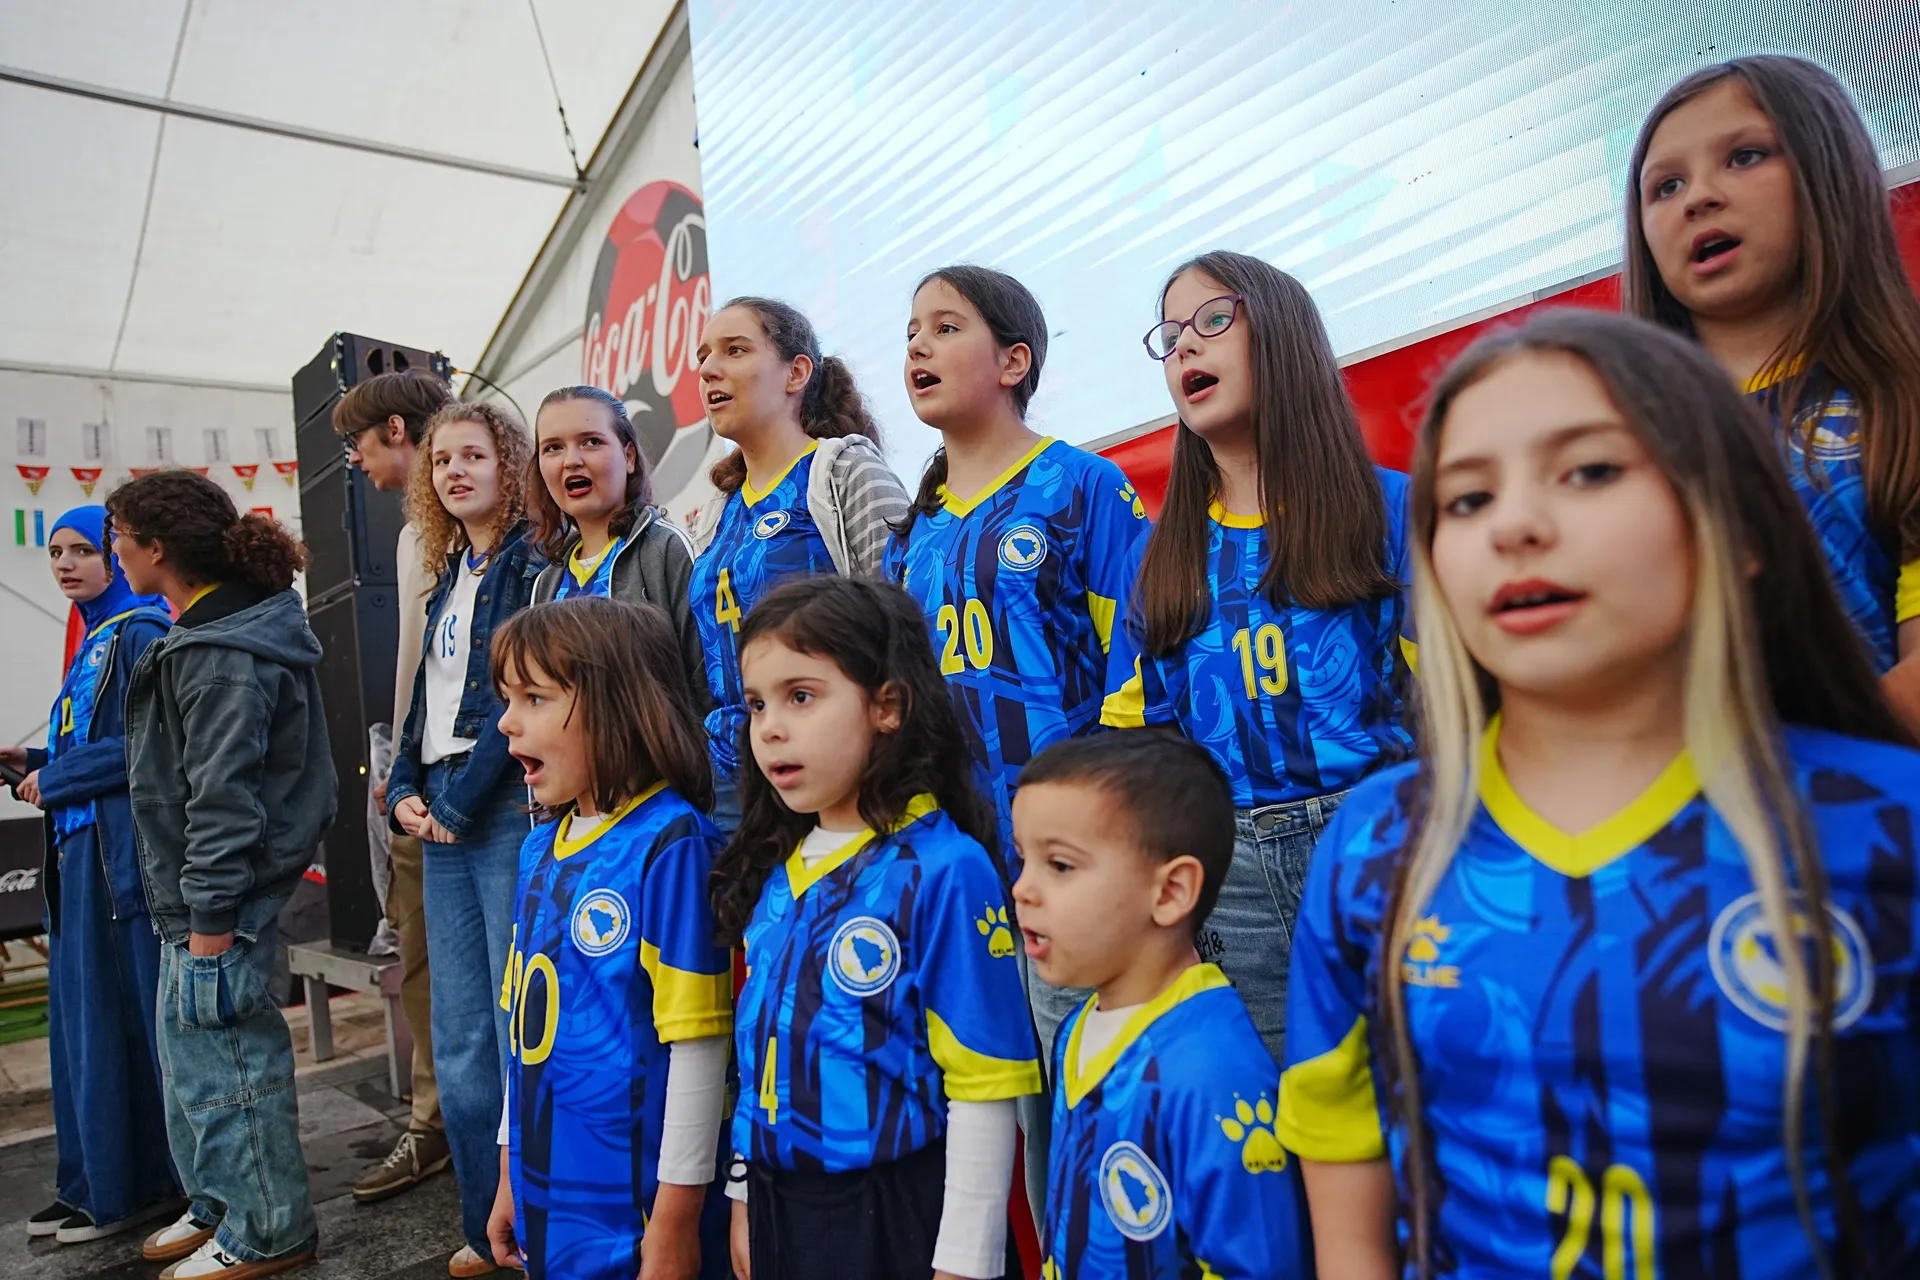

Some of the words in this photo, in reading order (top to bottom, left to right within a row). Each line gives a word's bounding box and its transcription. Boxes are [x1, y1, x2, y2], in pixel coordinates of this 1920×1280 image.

[441, 614, 457, 659] 19
[714, 567, 742, 634] 4
[936, 598, 994, 676] 20
[1231, 622, 1289, 700] 19
[759, 1035, 779, 1126] 4
[1545, 1154, 1656, 1280] 20
